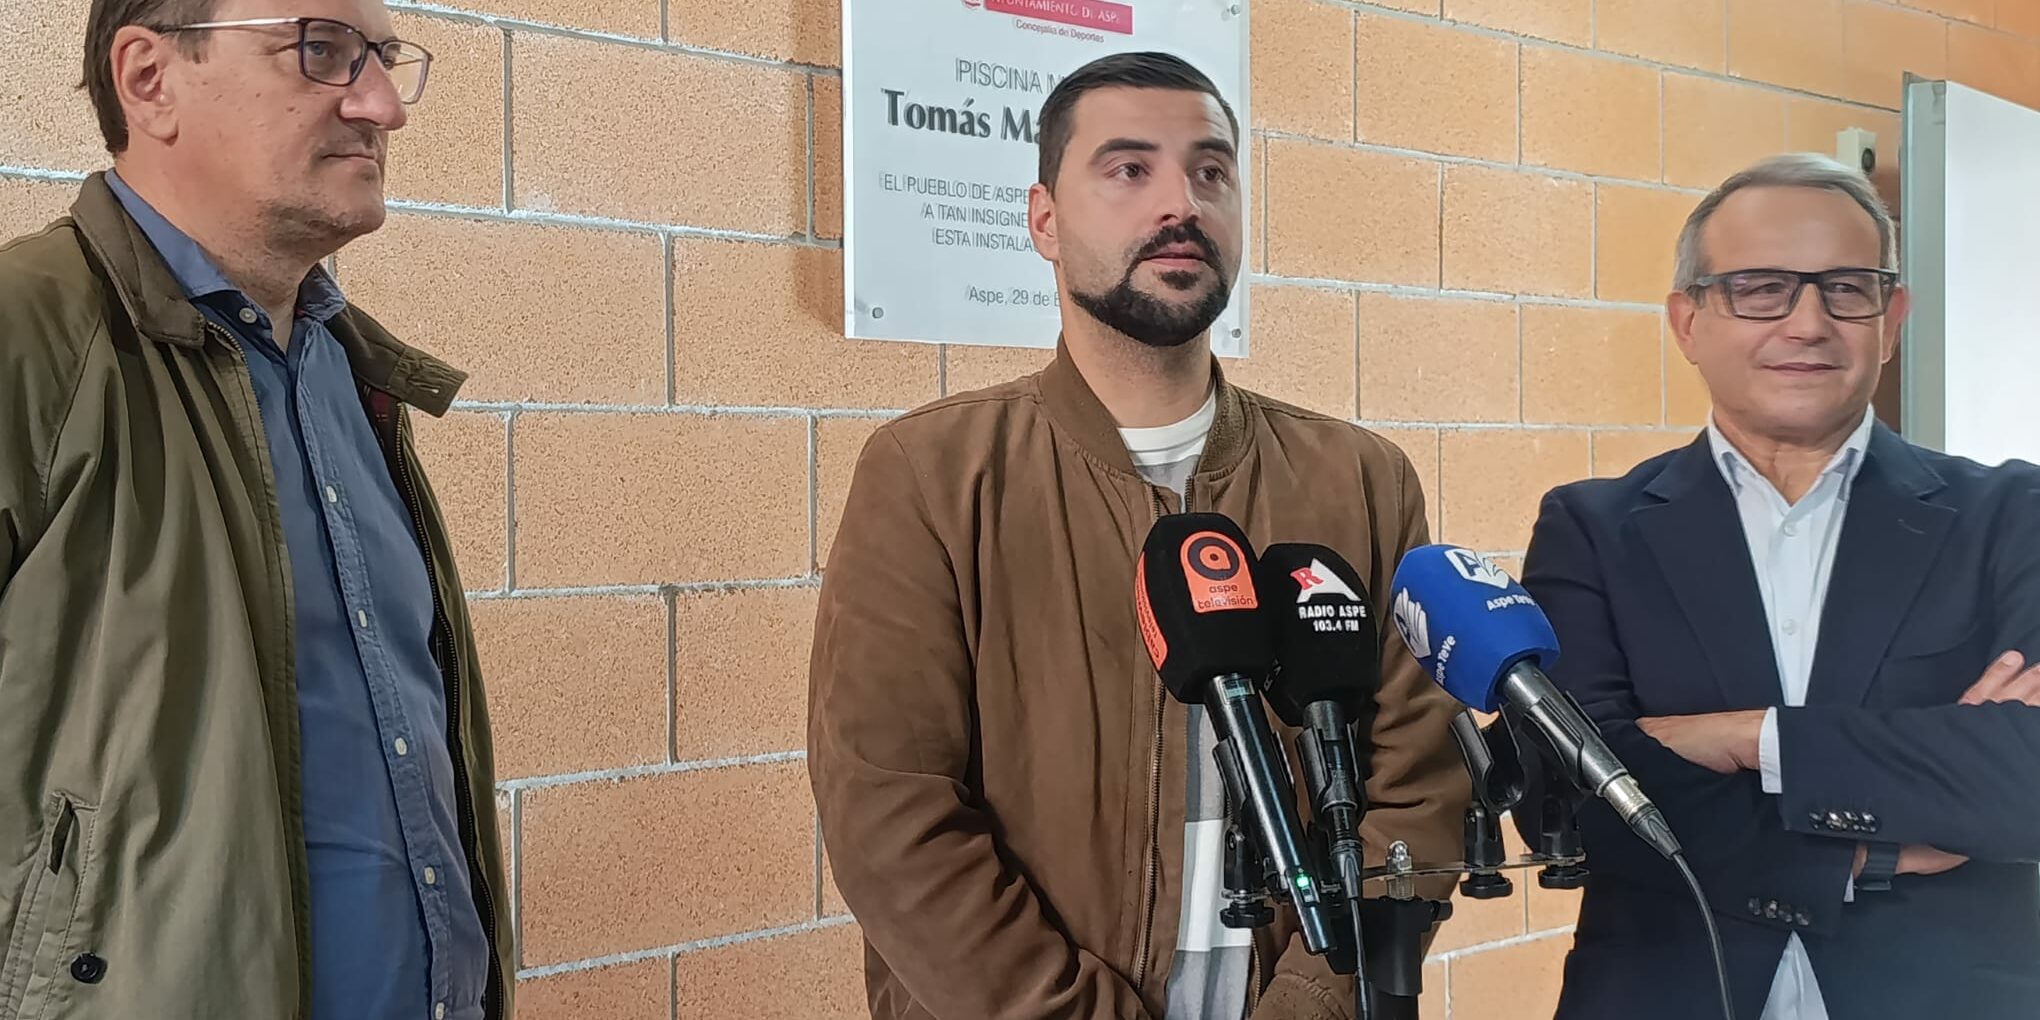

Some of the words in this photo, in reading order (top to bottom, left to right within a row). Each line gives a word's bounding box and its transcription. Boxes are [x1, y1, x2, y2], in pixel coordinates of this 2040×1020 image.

[991, 0, 1079, 17] YUNTAMIENTO
[1058, 27, 1070, 37] de
[1070, 28, 1105, 43] Deportes
[957, 58, 1043, 95] PISCINA
[883, 88, 992, 139] Tomás
[883, 173, 903, 192] EL
[906, 175, 968, 199] PUEBLO
[970, 183, 992, 201] DE
[995, 185, 1030, 205] ASPE
[923, 203, 935, 220] A
[938, 203, 967, 223] TAN
[971, 207, 1029, 229] INSIGNE
[934, 228, 971, 247] ESTA
[1012, 288, 1029, 306] 29
[1032, 290, 1050, 307] de
[1208, 583, 1239, 596] aspe
[1197, 594, 1255, 610] televisión
[1486, 595, 1515, 611] Aspe
[1298, 604, 1336, 620] RADIO
[1338, 604, 1368, 618] ASPE
[1312, 619, 1343, 632] 103.4
[1344, 619, 1360, 632] FM
[1437, 635, 1457, 664] TeVe
